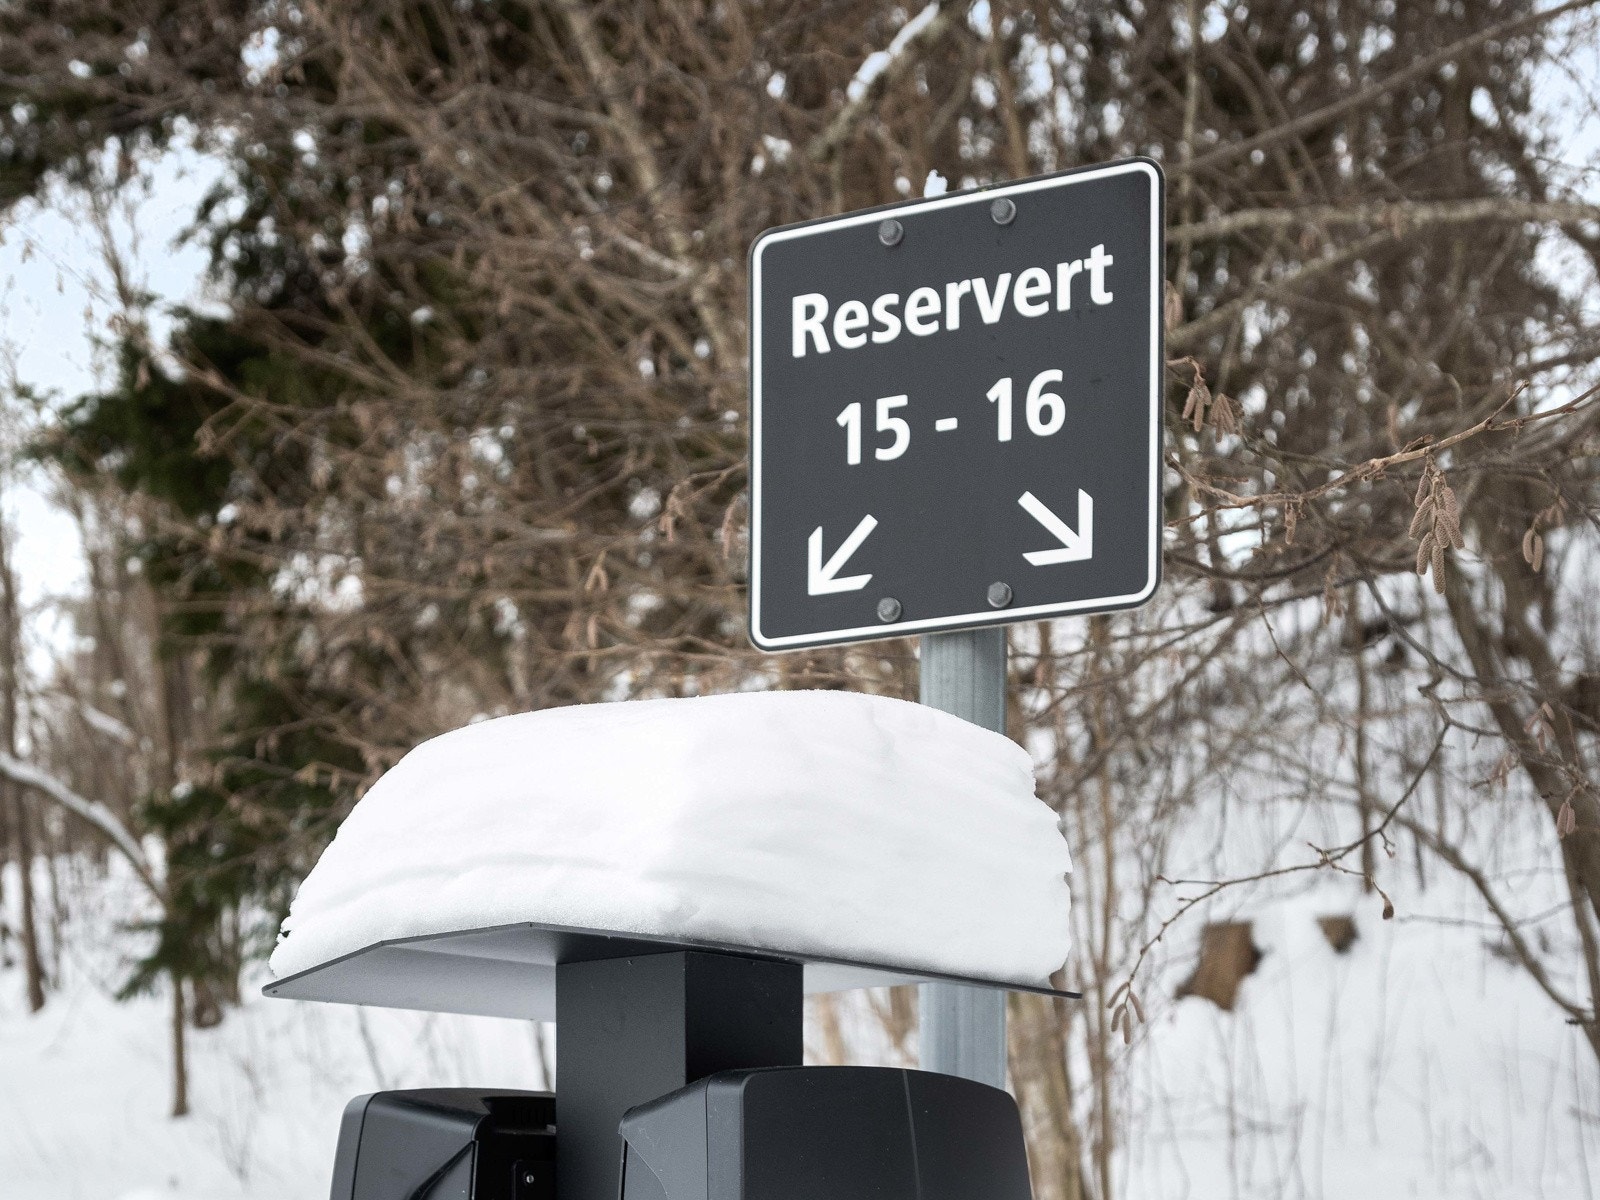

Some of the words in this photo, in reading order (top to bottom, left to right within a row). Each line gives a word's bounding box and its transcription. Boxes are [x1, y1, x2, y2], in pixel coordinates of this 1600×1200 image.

[792, 243, 1114, 358] Reservert
[836, 394, 911, 466] 15
[935, 417, 958, 432] -
[986, 368, 1067, 443] 16
